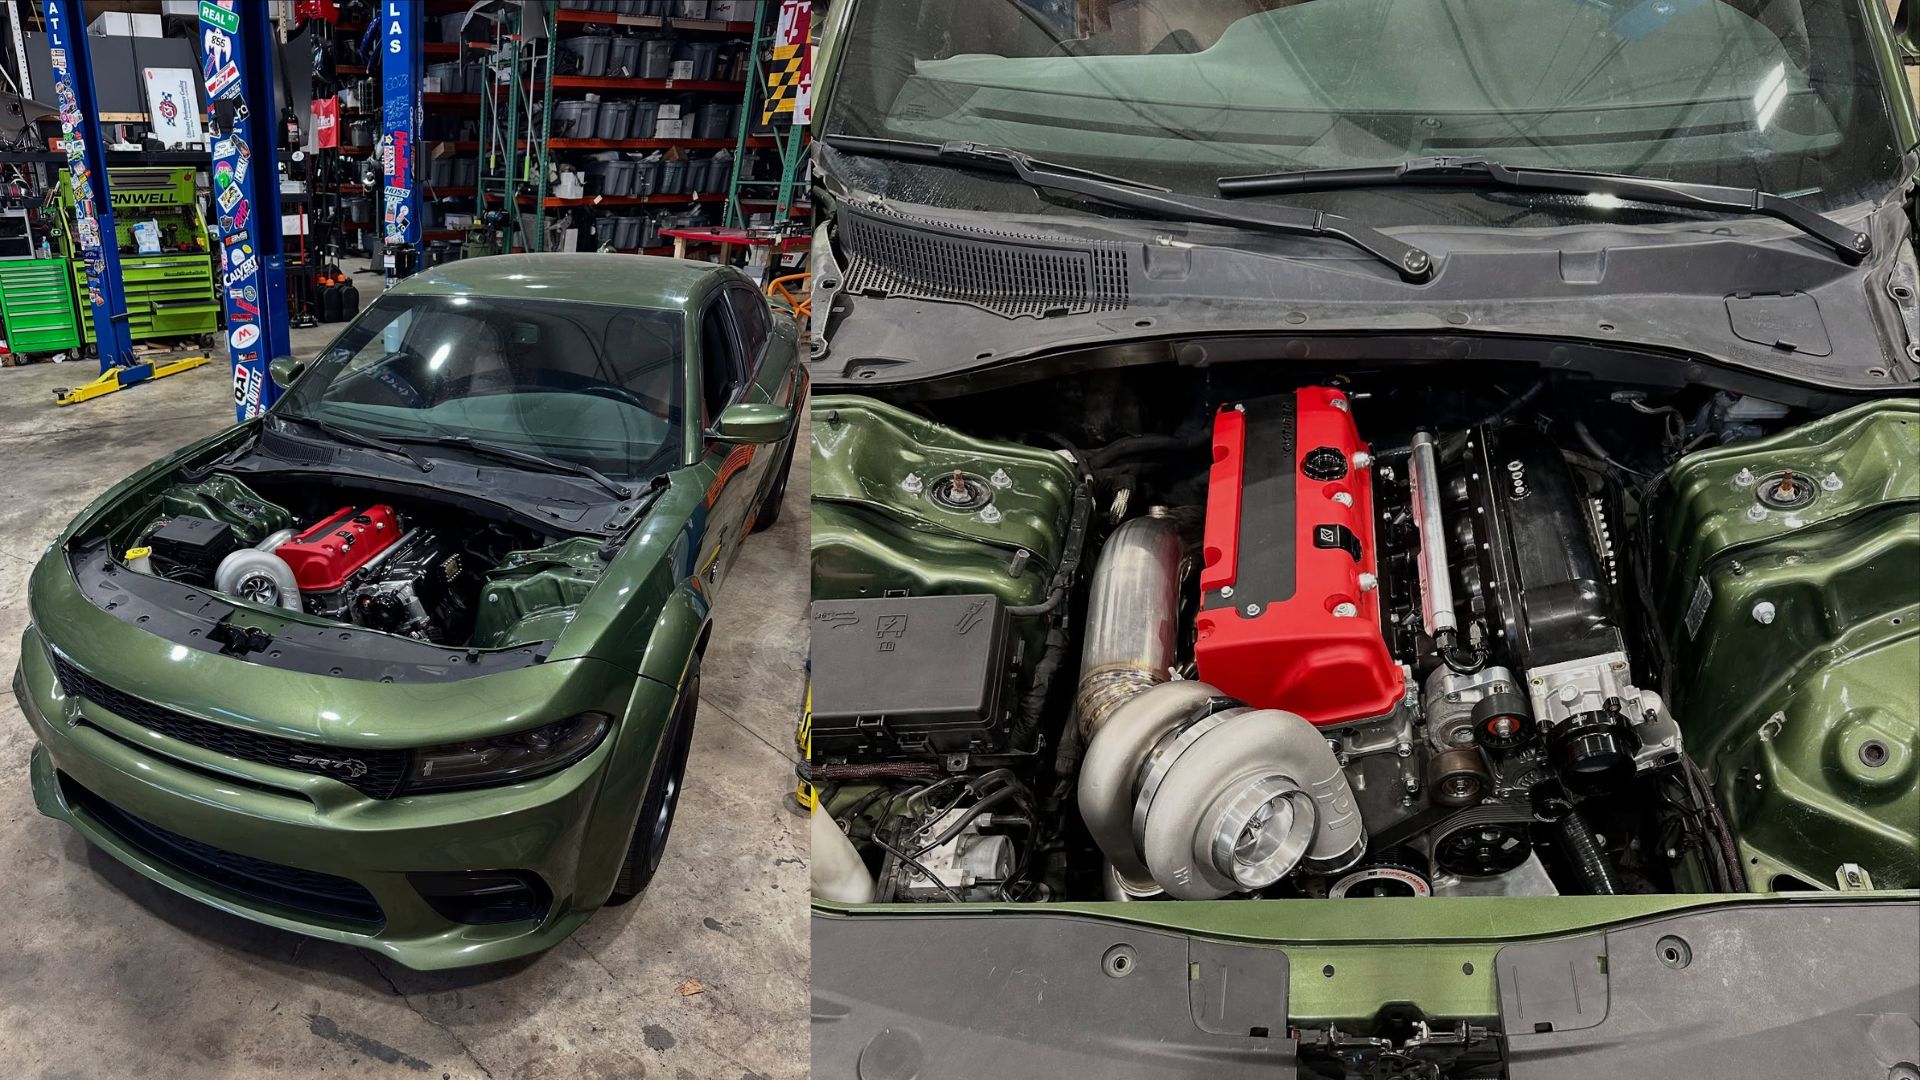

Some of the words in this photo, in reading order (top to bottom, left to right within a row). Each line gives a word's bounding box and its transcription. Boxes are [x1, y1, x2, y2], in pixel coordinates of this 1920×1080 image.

[202, 6, 226, 25] REAL
[389, 2, 402, 53] LAS
[49, 2, 67, 75] ATLS
[211, 35, 226, 48] 855
[391, 131, 408, 189] Holley
[223, 255, 256, 287] CALVERT
[234, 367, 248, 402] QA1
[289, 755, 352, 770] SRT
